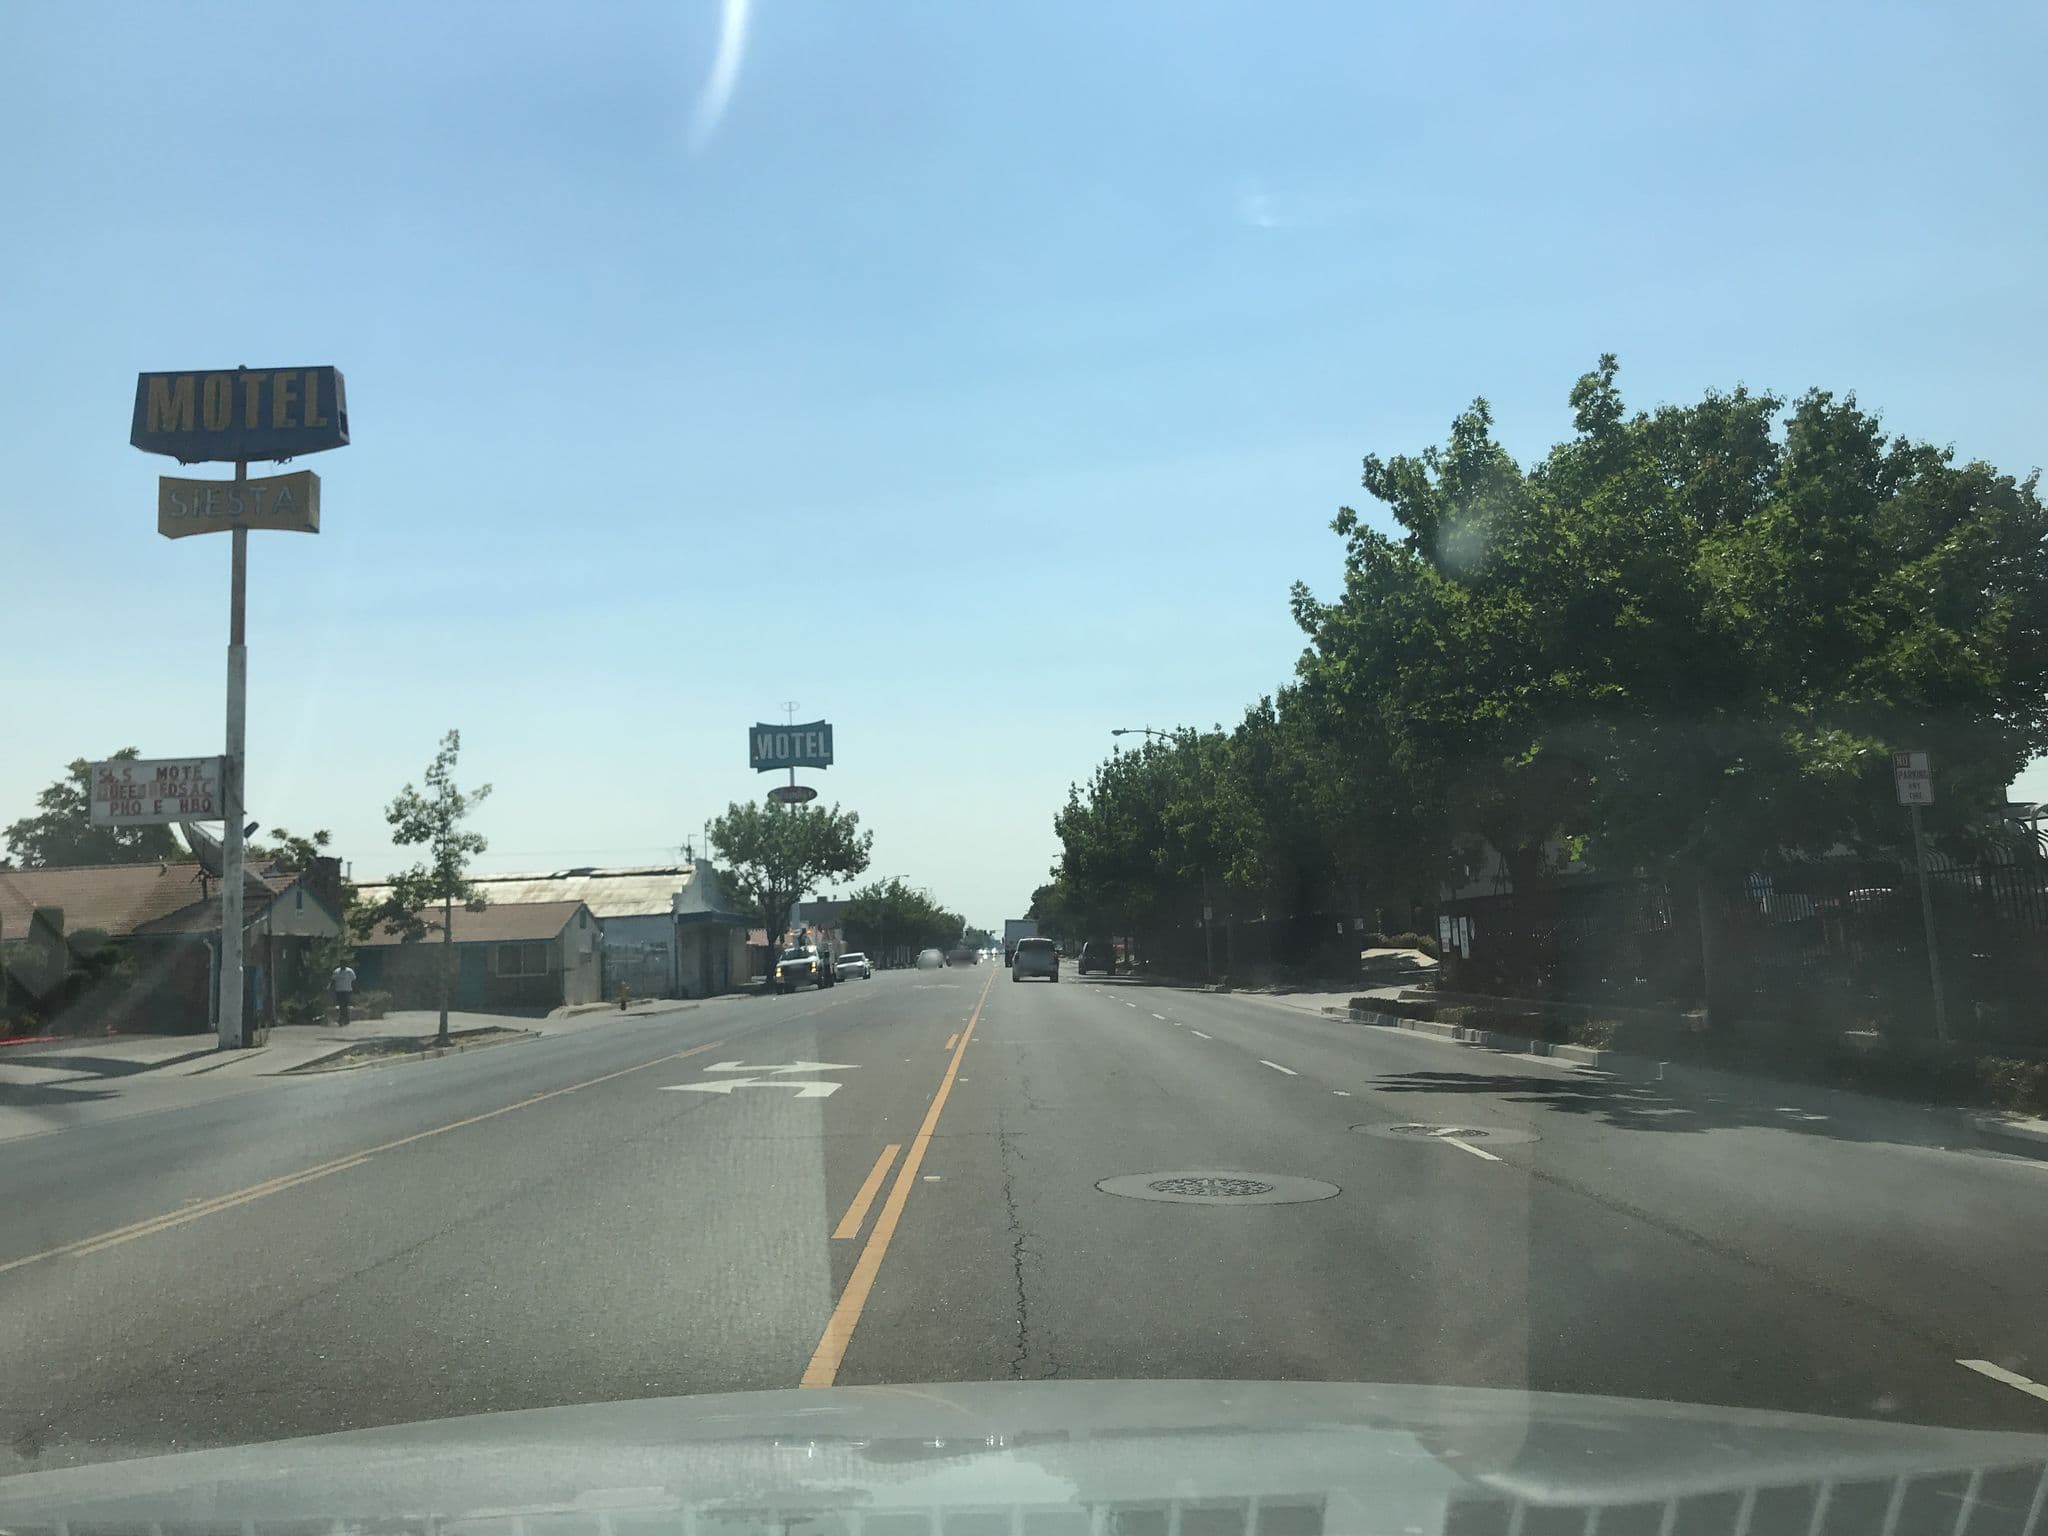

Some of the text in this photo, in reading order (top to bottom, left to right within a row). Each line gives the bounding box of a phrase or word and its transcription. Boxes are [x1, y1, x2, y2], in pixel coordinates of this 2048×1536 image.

[146, 370, 328, 433] MOTEL
[168, 485, 298, 519] SIESTA
[757, 731, 830, 760] MOTEL
[179, 797, 214, 814] HBO
